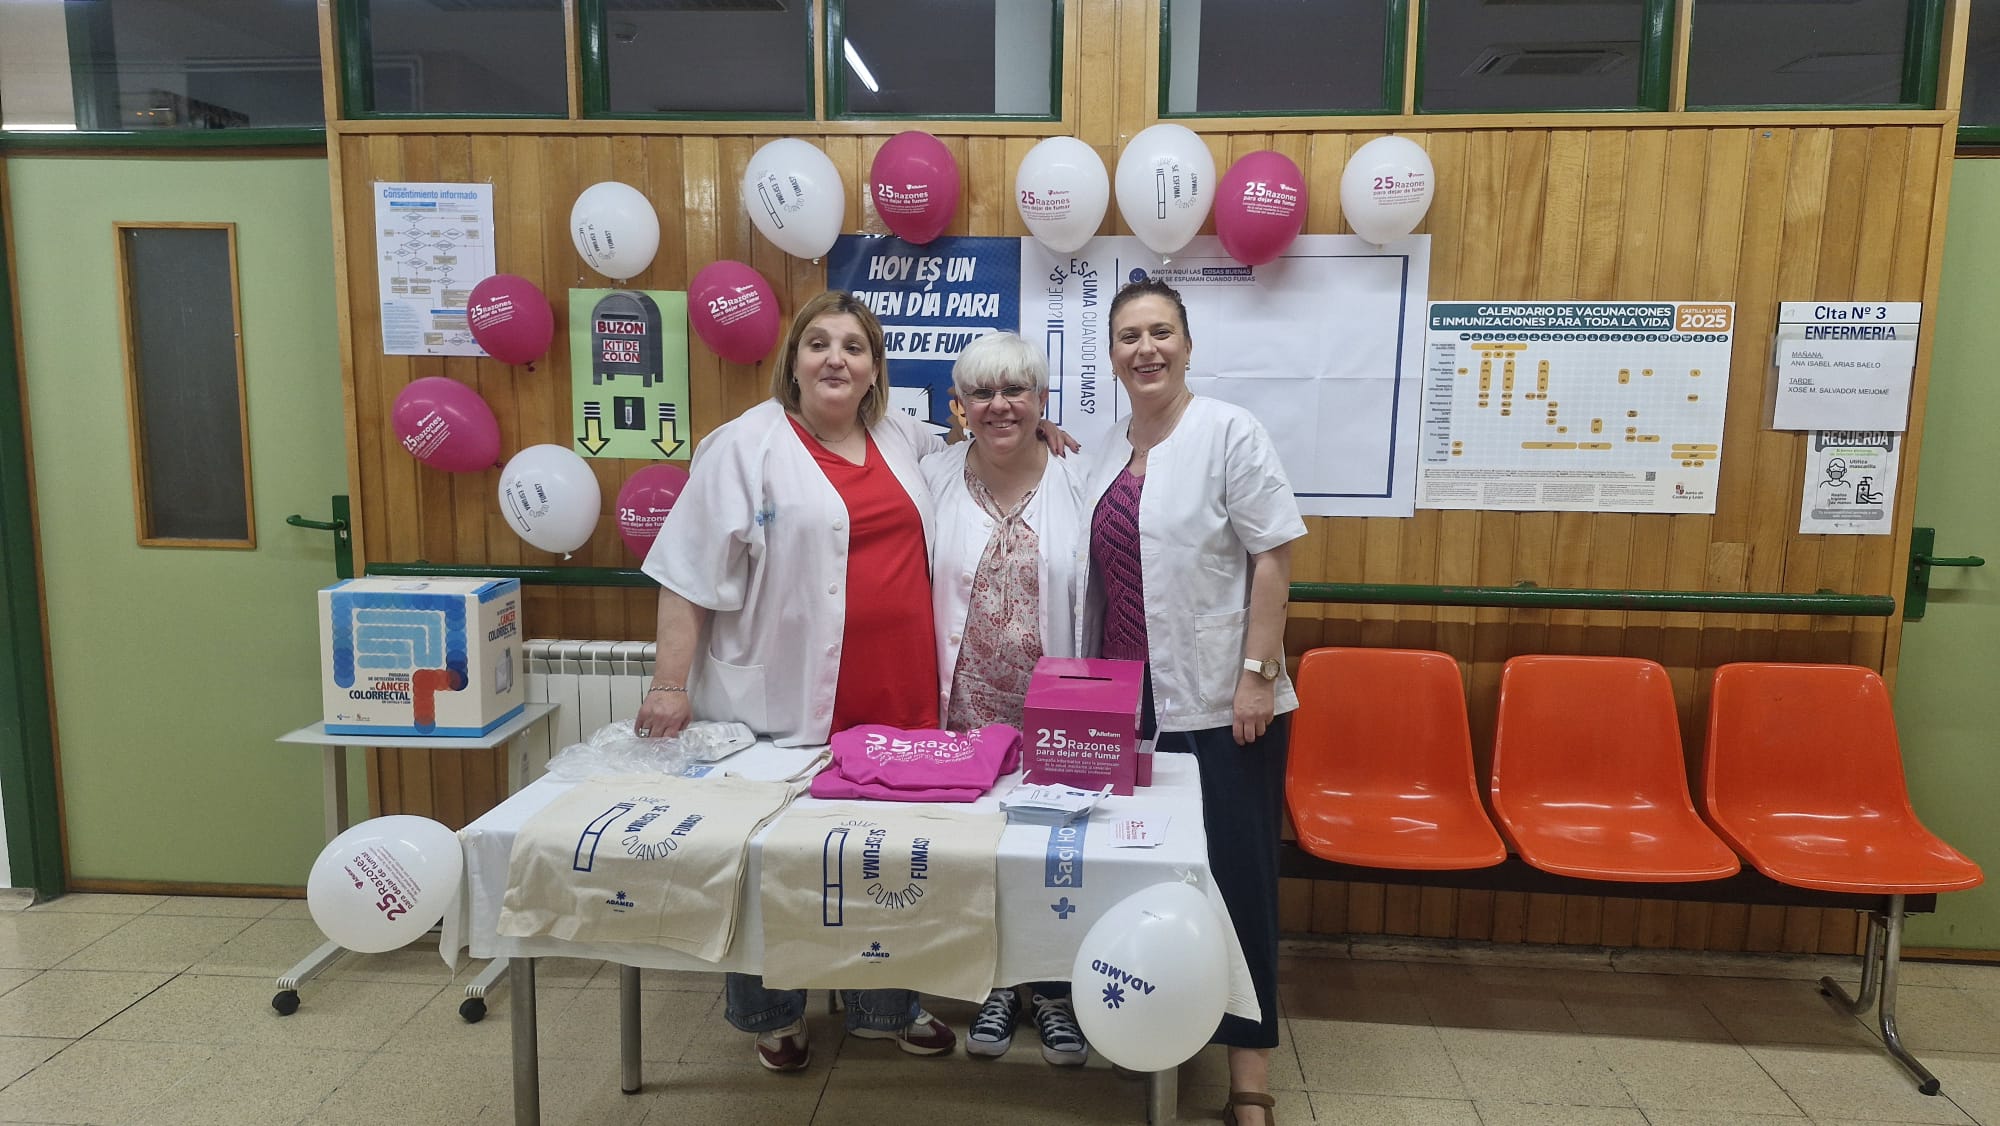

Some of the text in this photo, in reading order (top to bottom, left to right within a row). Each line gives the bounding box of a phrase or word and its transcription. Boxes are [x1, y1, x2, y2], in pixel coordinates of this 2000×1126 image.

[878, 184, 894, 198] 25
[1173, 175, 1181, 198] ESFUMA
[1244, 181, 1297, 202] 25 Razones
[1373, 176, 1394, 190] 25
[383, 189, 477, 200] Consentimiento informado
[1021, 190, 1070, 206] 25 Razones
[869, 256, 976, 282] HOY ES UN
[1050, 265, 1069, 285] SE
[1070, 259, 1098, 307] ESFUMA
[708, 296, 728, 314] 25
[727, 290, 758, 307] Razones
[906, 282, 940, 317] DÍA
[945, 293, 999, 318] PARA
[470, 304, 483, 318] 25
[1478, 307, 1671, 317] CALENDARIO DE VACUNACIONES
[1681, 314, 1726, 328] 2025
[1852, 307, 1871, 320] Nº
[1875, 307, 1886, 320] 3
[1433, 317, 1670, 327] E INMUNIZACIONES PARA TODA LA VIDA
[909, 332, 931, 352] DE
[1081, 311, 1097, 361] CUANDO
[1805, 326, 1896, 340] ENFERMERIA
[604, 341, 638, 351] KIT DE
[1080, 365, 1096, 415] FUMAS?
[403, 434, 417, 452] 25
[414, 416, 442, 442] Razones
[1822, 431, 1889, 446] RECUERDA
[620, 507, 635, 521] 25
[349, 690, 411, 701] COLORRECTAL
[865, 733, 912, 752] 25
[1036, 728, 1121, 752] 25 Razones
[1057, 749, 1079, 758] dejar
[1081, 750, 1092, 758] de
[1095, 752, 1120, 760] fumar
[621, 835, 678, 860] CUANDO
[863, 836, 883, 880] ESFUMA
[353, 855, 388, 896] Razones
[361, 851, 414, 910] para dejar de fumar
[605, 899, 634, 908] ADAMED
[867, 882, 924, 909] CUANDO
[376, 894, 407, 921] 25
[1091, 959, 1156, 995] ADAMED
